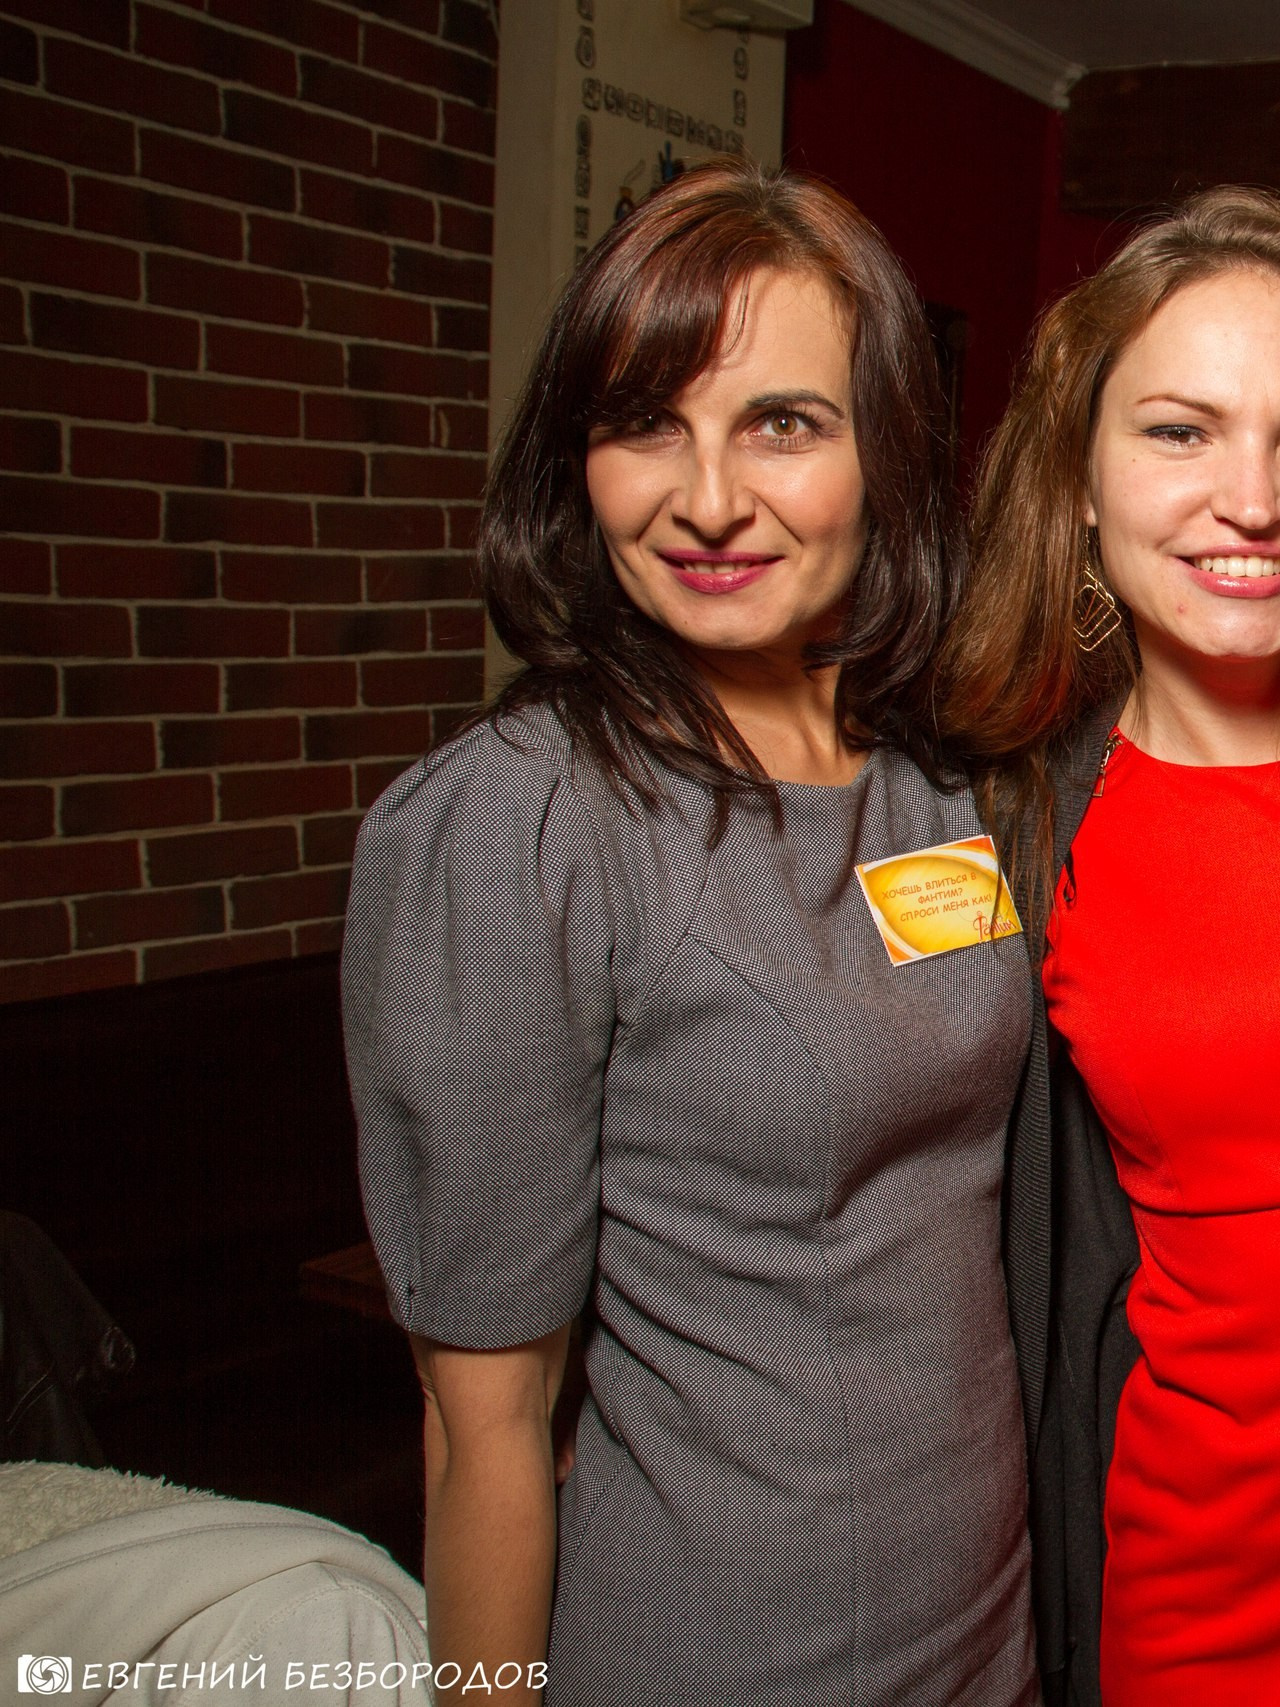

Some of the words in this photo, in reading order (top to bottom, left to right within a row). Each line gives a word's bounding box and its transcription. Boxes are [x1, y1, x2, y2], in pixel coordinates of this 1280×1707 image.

[882, 885, 922, 900] ХОЧЕШЬ
[925, 875, 967, 890] ВЛИТЬСЯ
[918, 888, 963, 904] ФАНТИМ?
[900, 907, 939, 921] СПРОСИ
[942, 901, 969, 912] МЕНЯ
